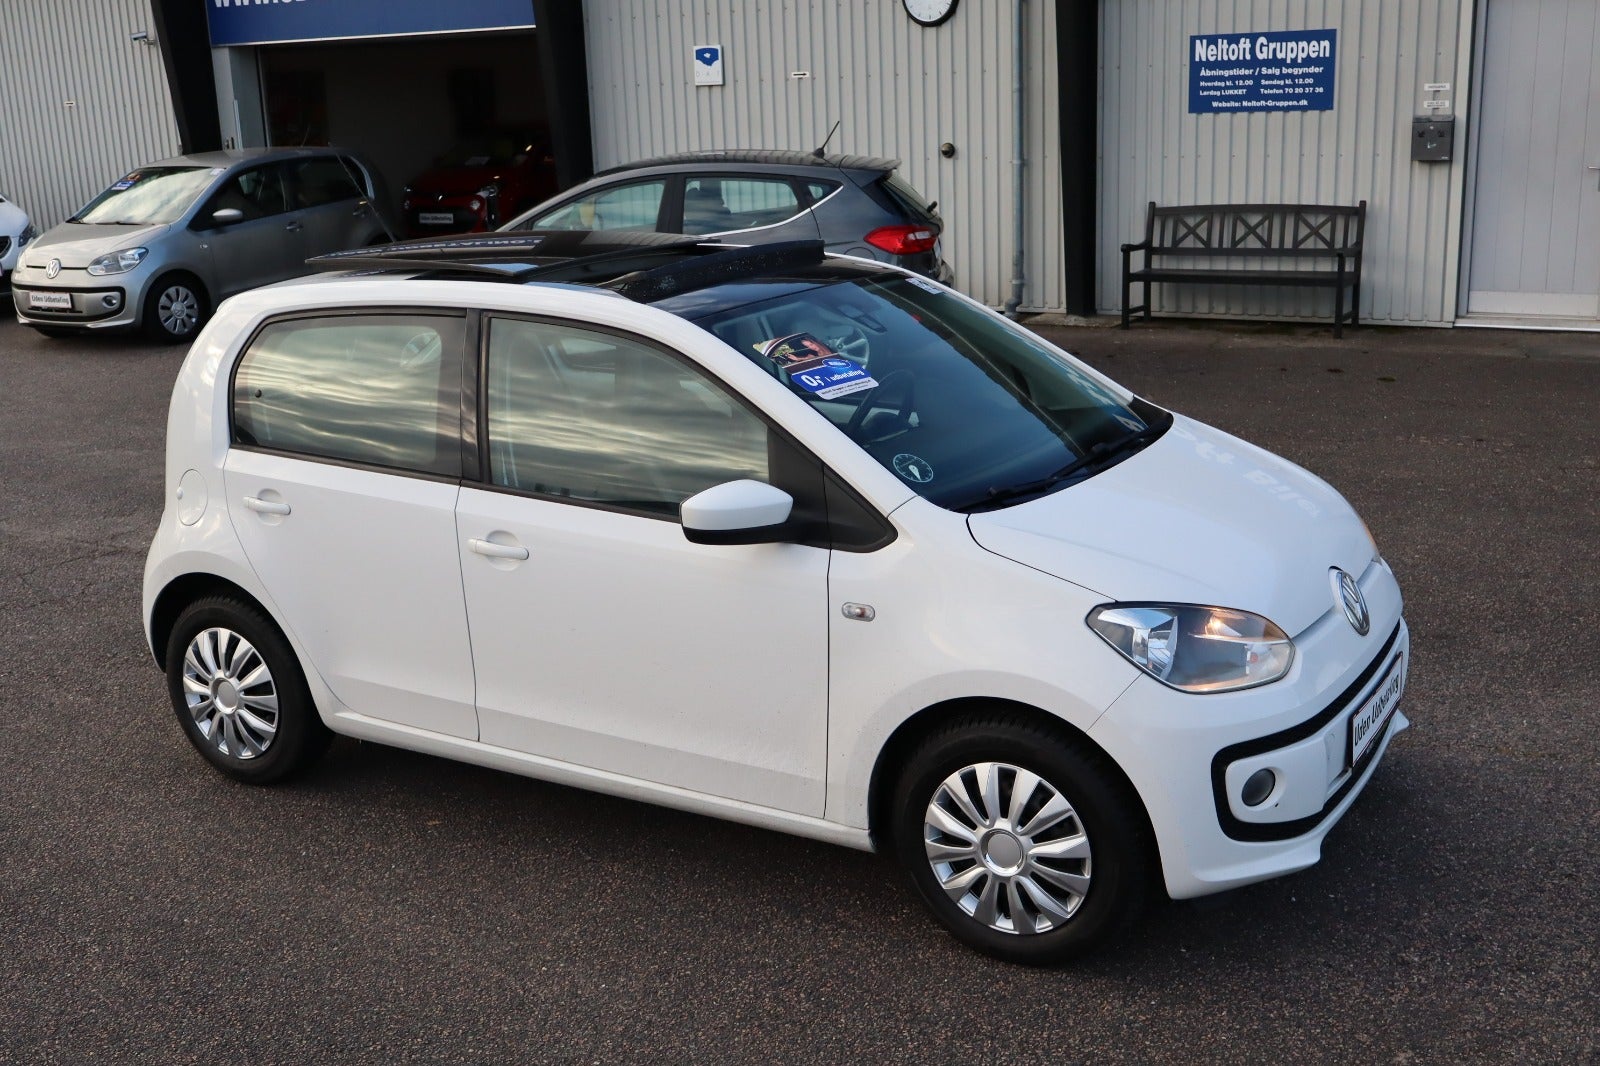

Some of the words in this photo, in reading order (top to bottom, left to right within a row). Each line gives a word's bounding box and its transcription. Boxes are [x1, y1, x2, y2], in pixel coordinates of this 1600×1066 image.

[1195, 37, 1251, 62] Neltoft
[1255, 36, 1331, 64] Gruppen
[1199, 66, 1254, 77] Åbningstider
[1261, 66, 1281, 76] Salg
[1281, 65, 1324, 76] begynder
[1242, 99, 1309, 108] Neltoft-Gruppen.dk
